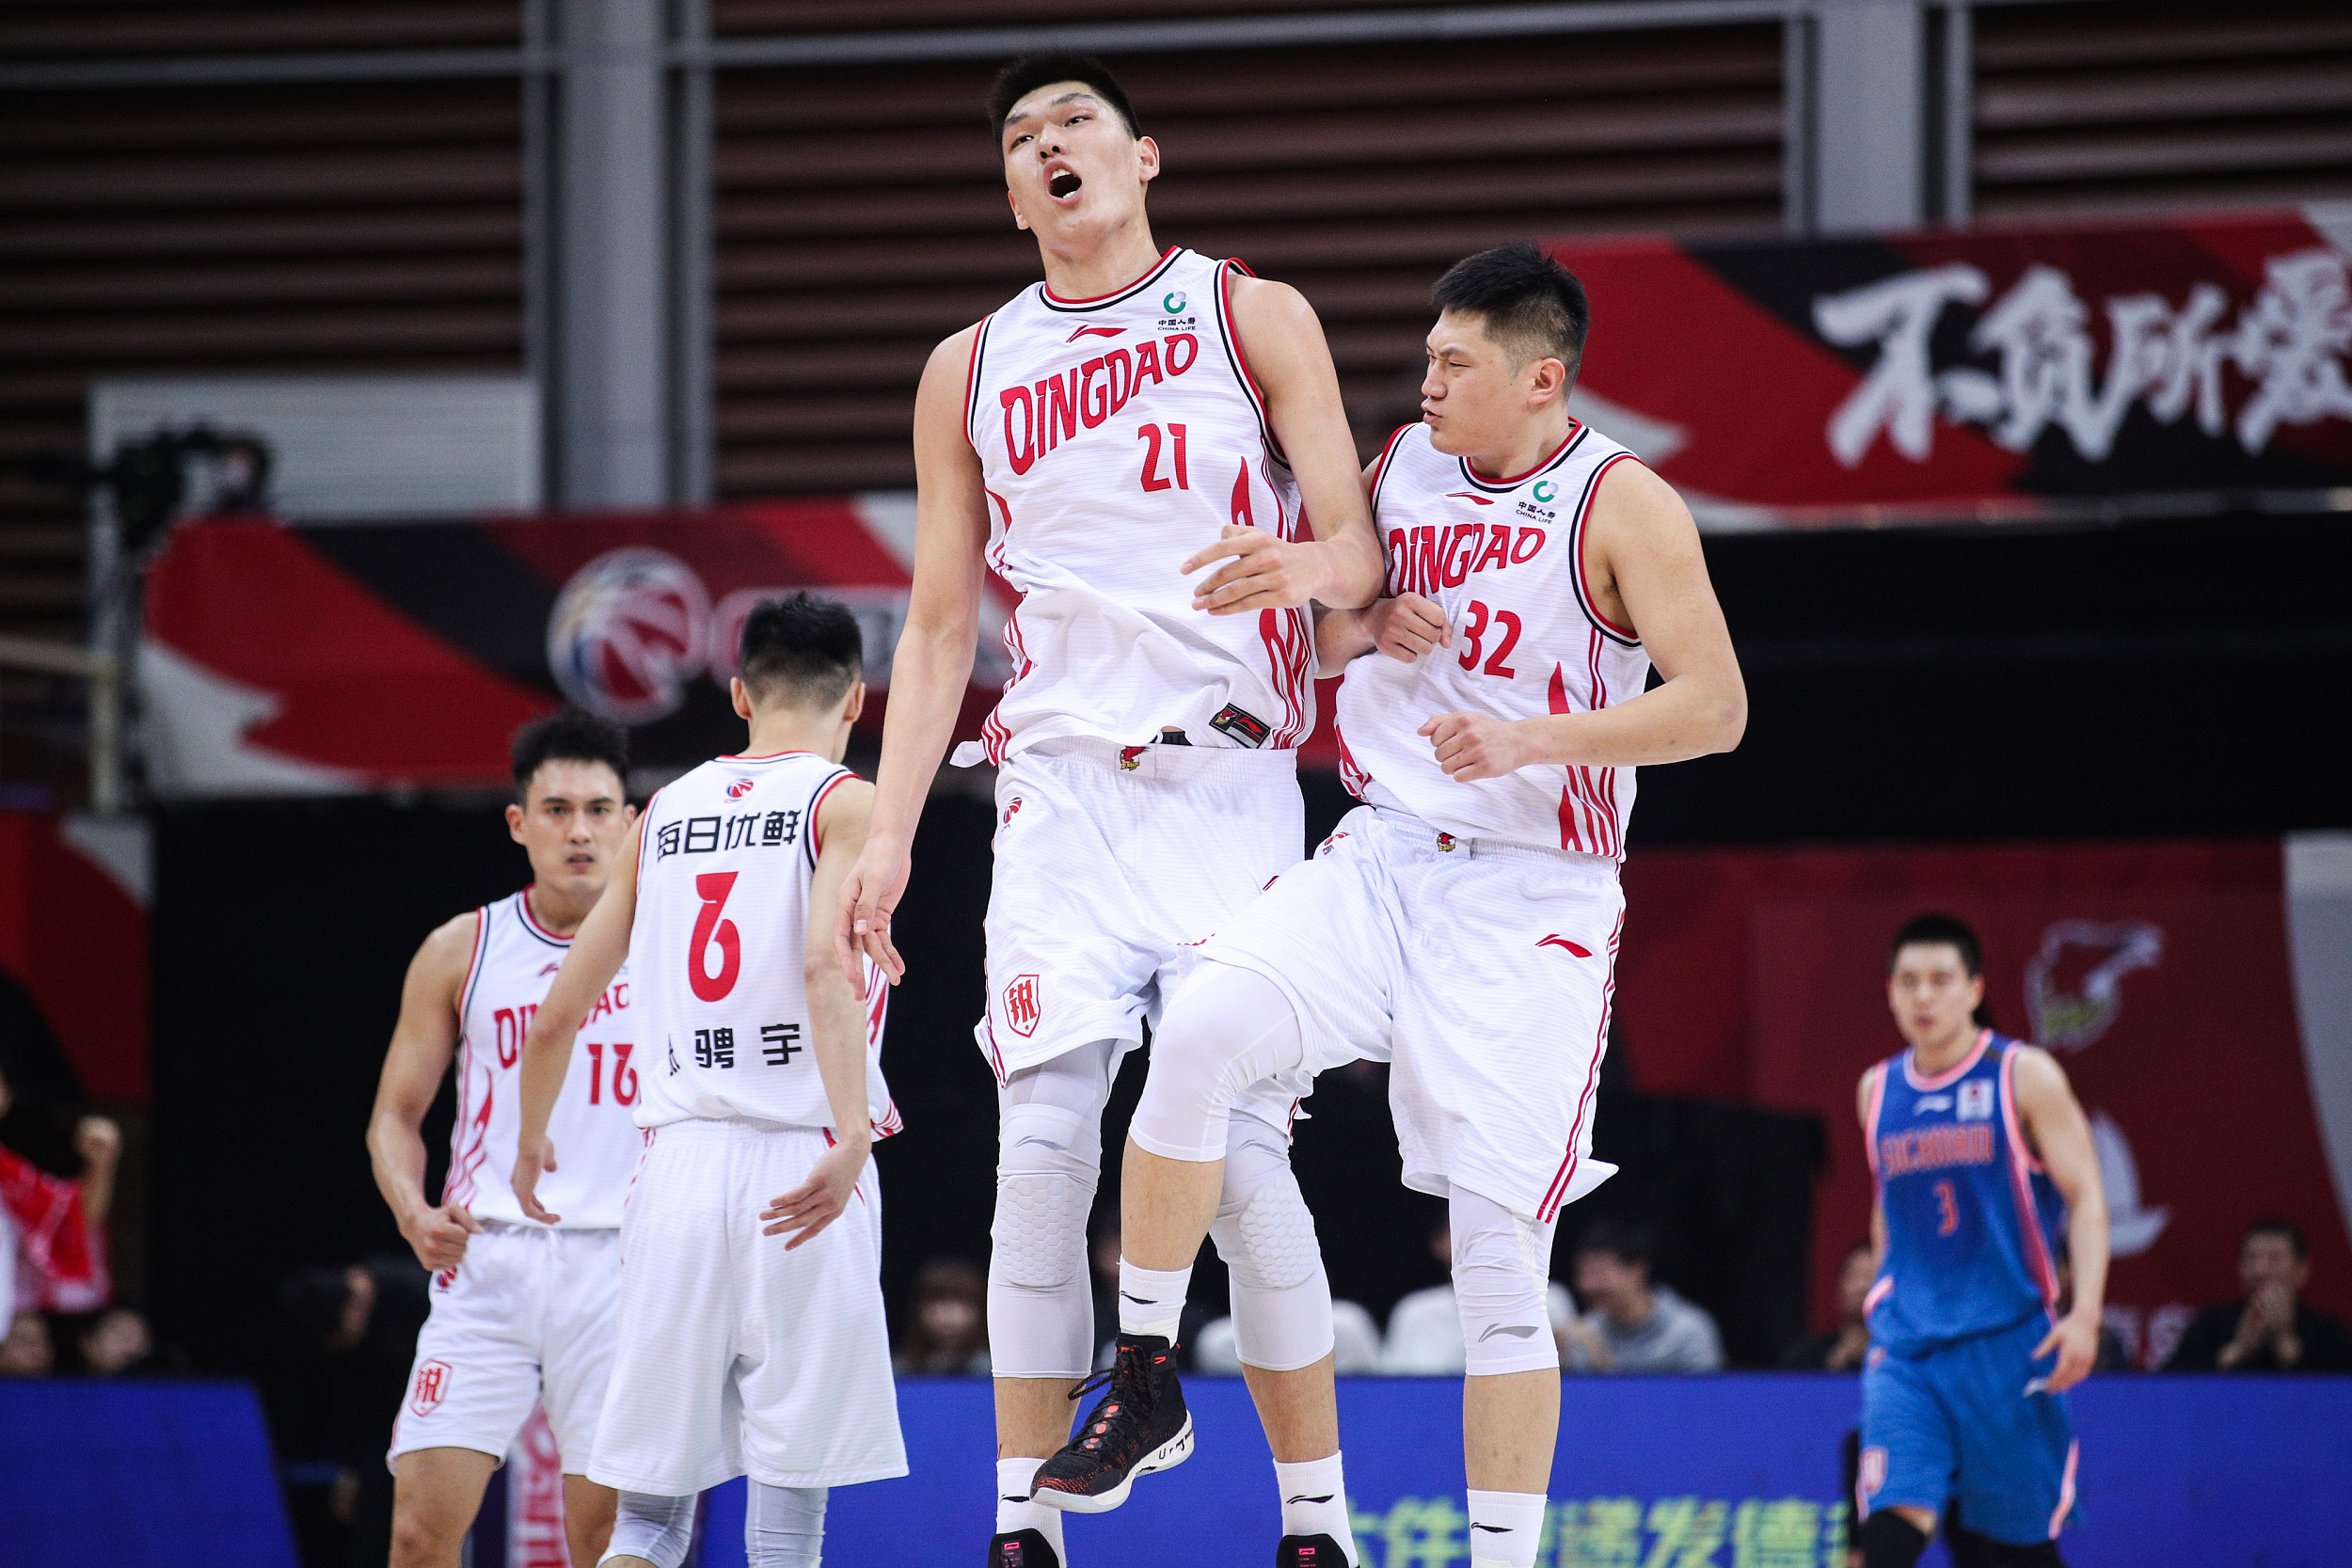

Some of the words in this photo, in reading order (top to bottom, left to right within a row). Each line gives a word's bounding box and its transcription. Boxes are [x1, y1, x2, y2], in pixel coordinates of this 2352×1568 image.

[999, 333, 1198, 476] QINGDAO
[1137, 422, 1189, 491] 21
[1516, 509, 1536, 520] CHINA
[1458, 599, 1522, 679] 32
[689, 871, 740, 1002] 6
[588, 1043, 638, 1106] 16
